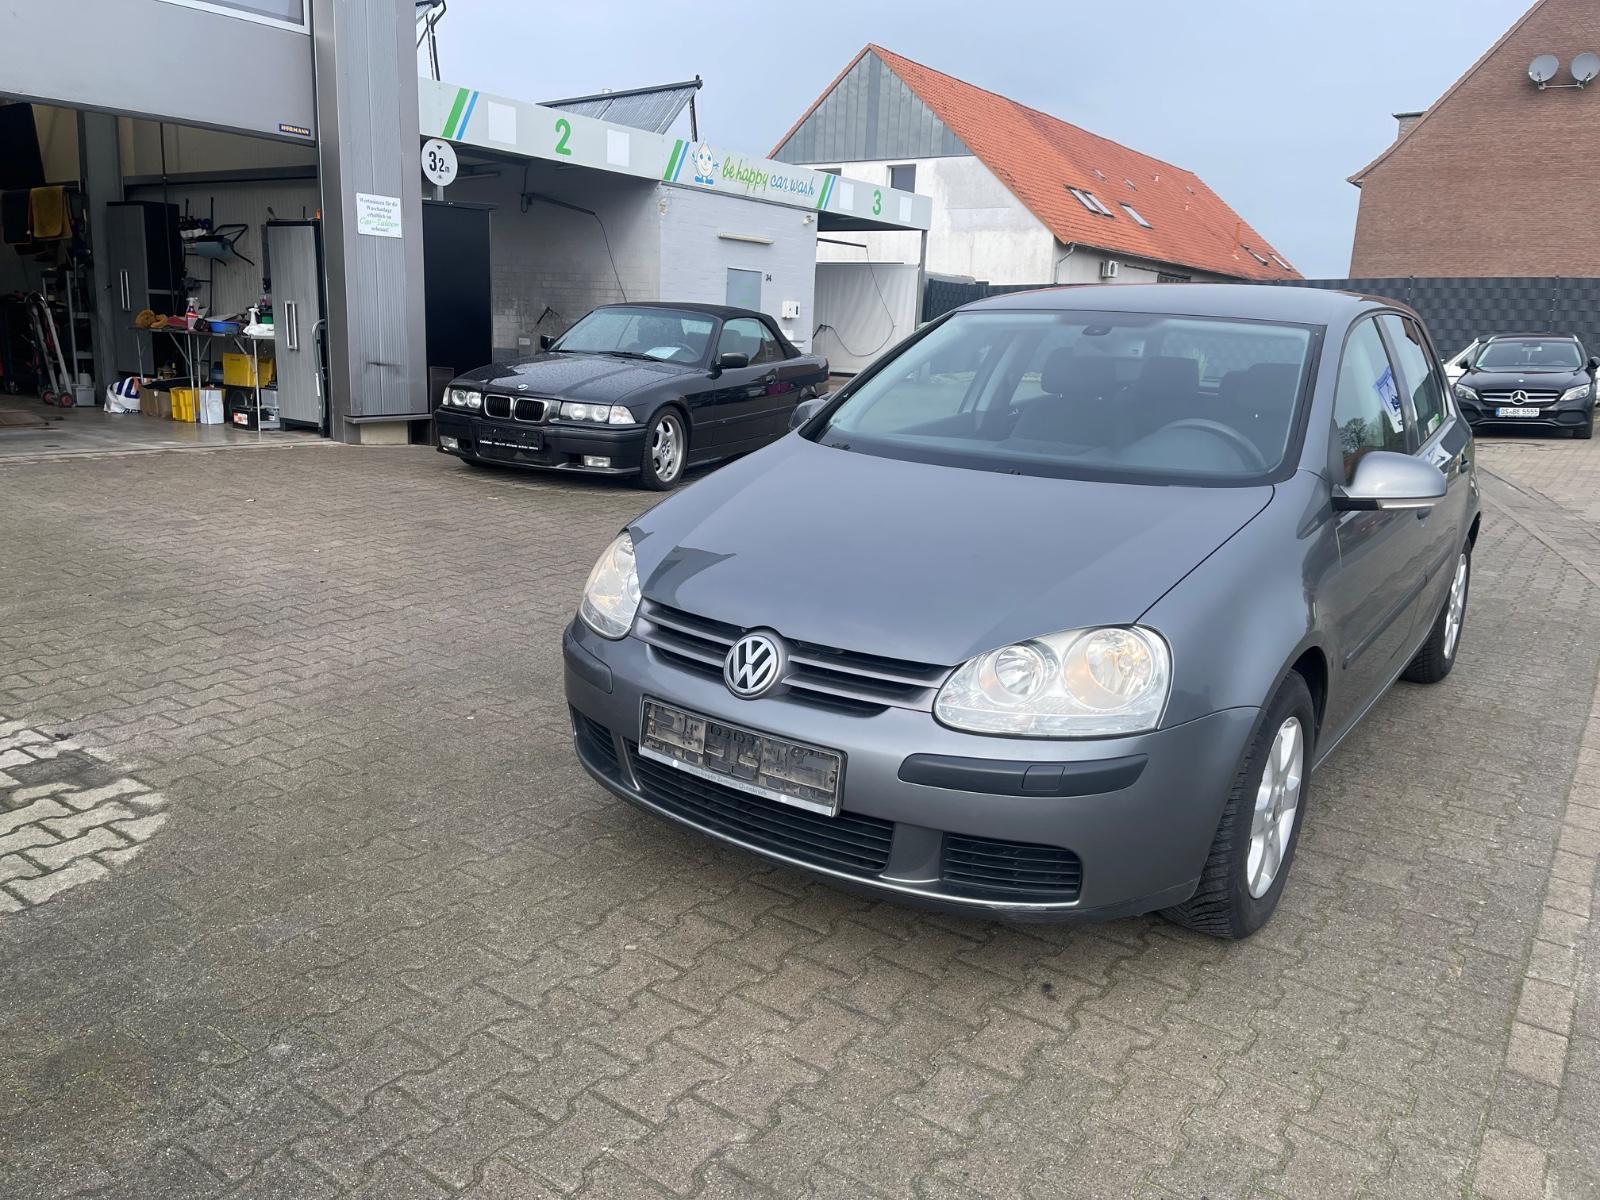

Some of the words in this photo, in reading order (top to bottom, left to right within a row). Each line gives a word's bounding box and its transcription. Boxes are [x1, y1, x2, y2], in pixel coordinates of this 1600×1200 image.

[555, 118, 572, 156] 2
[722, 156, 735, 178] be
[735, 159, 769, 192] happy
[872, 190, 882, 216] 3
